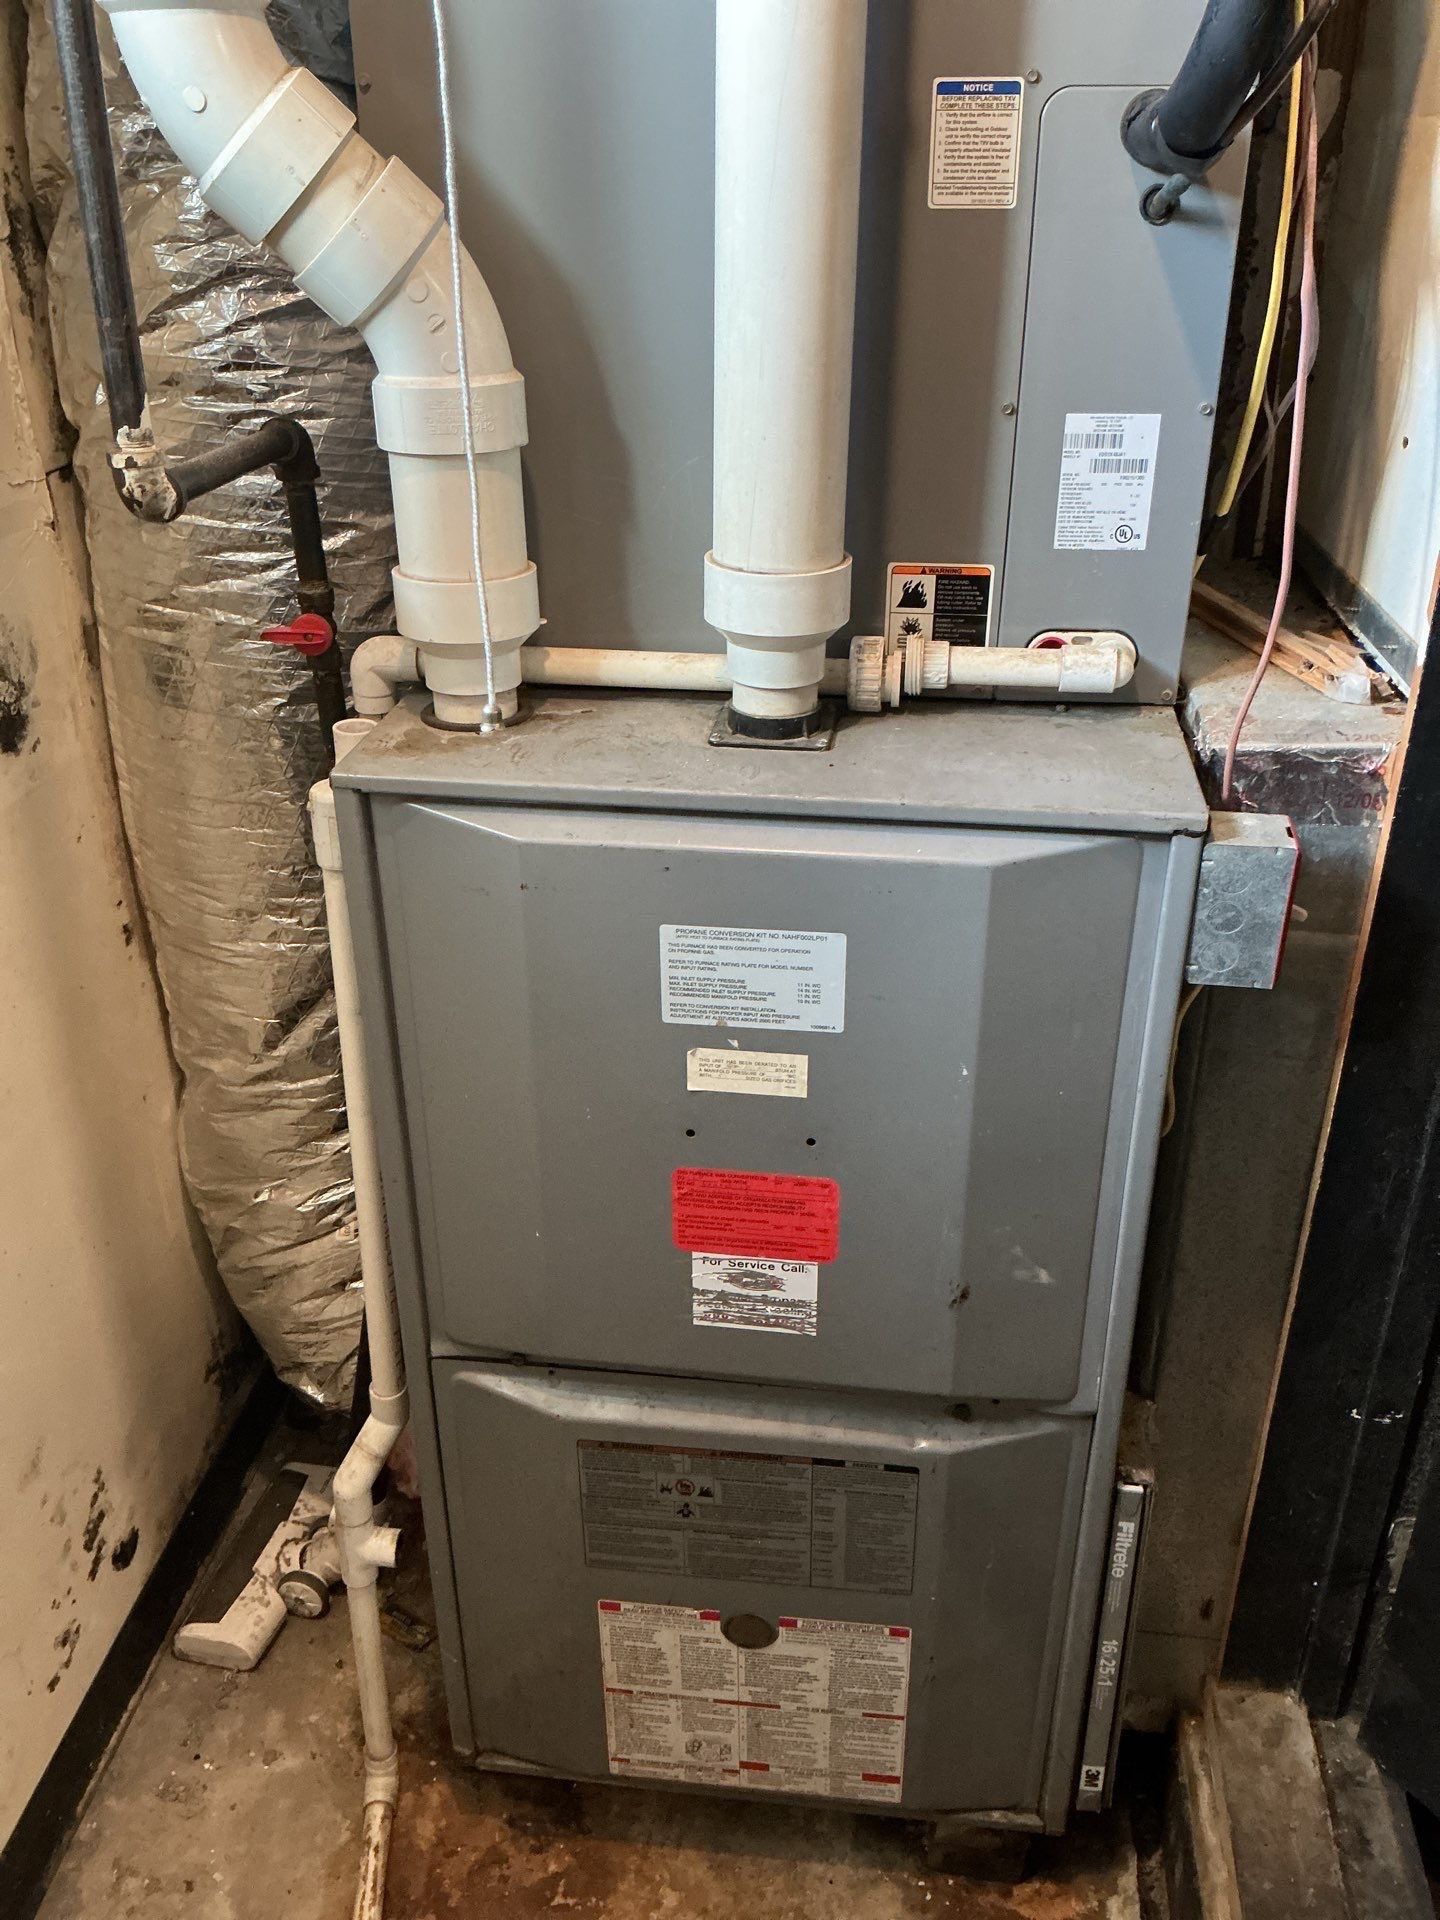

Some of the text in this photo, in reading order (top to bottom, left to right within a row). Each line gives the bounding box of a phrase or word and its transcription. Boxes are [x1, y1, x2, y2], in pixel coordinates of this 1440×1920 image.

[963, 83, 994, 92] NOTICE
[1119, 529, 1128, 539] UL
[709, 930, 755, 938] CONVERSION
[782, 934, 827, 942] NAHF002LP01
[669, 986, 710, 994] RECOMMENDED
[702, 1257, 721, 1266] For
[728, 1259, 775, 1271] Service
[1111, 1521, 1135, 1578] Filtrete
[1084, 1769, 1100, 1788] 3M
